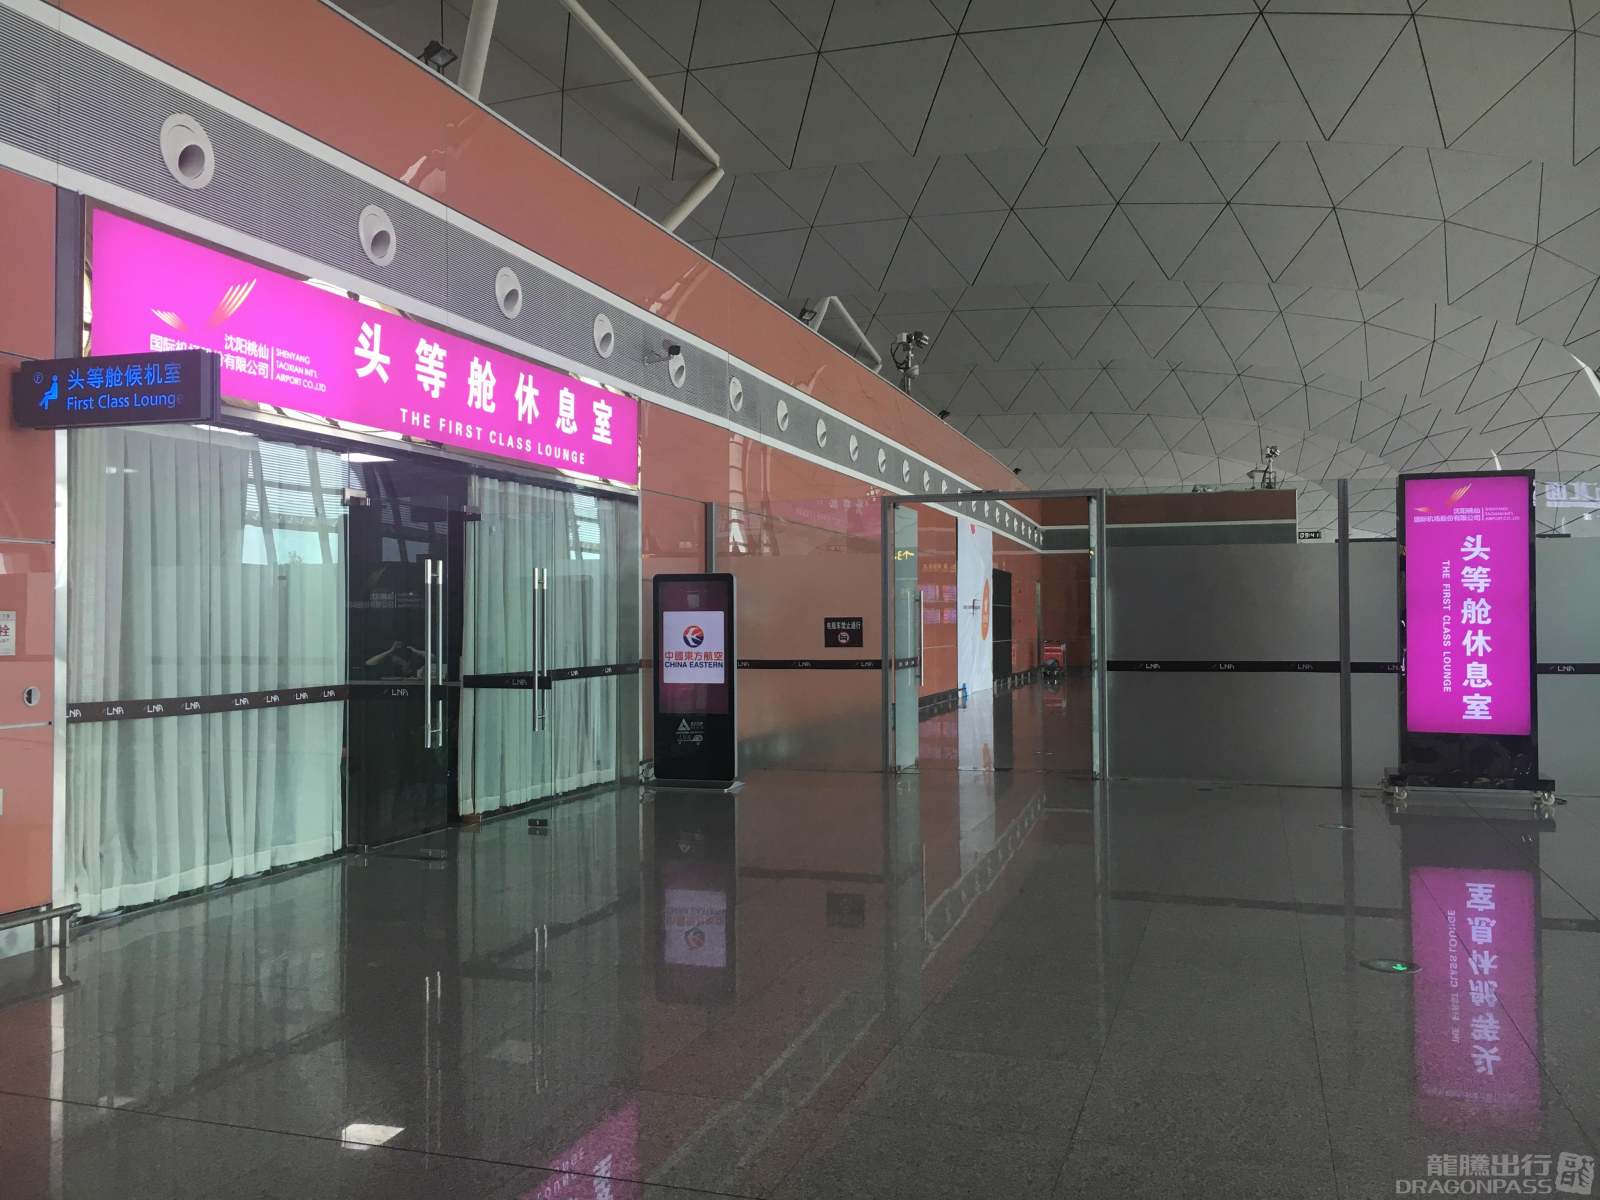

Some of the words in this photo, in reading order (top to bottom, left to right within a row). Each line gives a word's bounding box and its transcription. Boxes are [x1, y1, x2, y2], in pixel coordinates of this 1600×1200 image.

[224, 333, 269, 360] 沈阳桃仙
[275, 347, 310, 365] SHENYANG
[67, 362, 181, 390] 头等舱候机室
[354, 321, 613, 445] 头等舱休息室
[66, 396, 95, 411] First
[100, 393, 129, 409] Class
[400, 407, 431, 429] THE
[439, 417, 483, 441] FIRST
[489, 430, 532, 452] CLASS
[538, 441, 585, 465] LOUNGE
[1442, 560, 1450, 578] THE
[1442, 584, 1451, 610] FIRST
[1443, 615, 1451, 647] CLASS
[1460, 534, 1493, 720] 头等舱休息室
[664, 650, 724, 661] 中國東方航空
[664, 661, 688, 669] CHINA
[689, 661, 724, 669] EASTERN
[1443, 651, 1452, 692] LOUNGE
[106, 706, 124, 716] LNA
[147, 704, 164, 713] LNA
[185, 701, 200, 710] LNA
